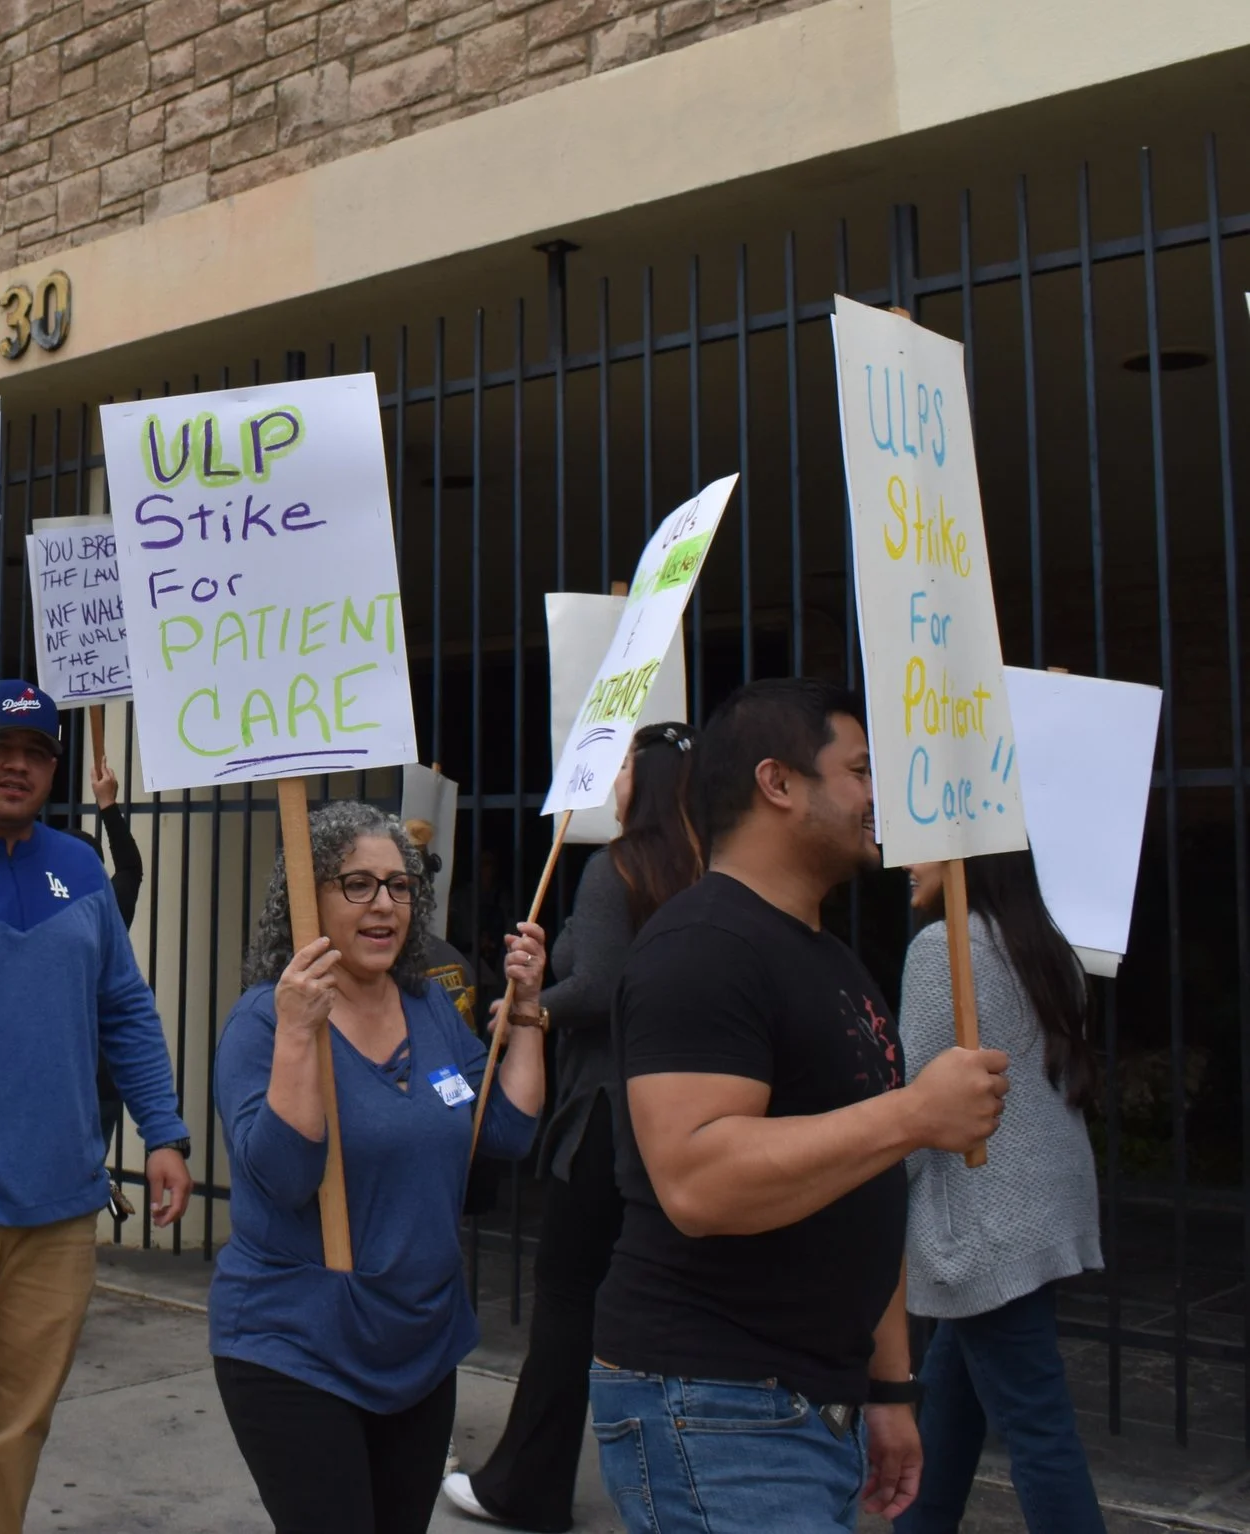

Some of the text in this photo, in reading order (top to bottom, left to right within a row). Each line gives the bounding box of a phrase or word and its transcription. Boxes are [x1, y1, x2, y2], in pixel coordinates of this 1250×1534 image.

[142, 405, 305, 488] ULP
[135, 492, 328, 550] Stike
[883, 474, 972, 579] Strike
[38, 534, 117, 567] YOU BRE
[40, 560, 120, 591] THE LAW
[149, 568, 243, 609] For
[159, 592, 401, 672] PATIENT
[910, 590, 952, 649] For
[51, 650, 100, 671] THE
[1, 697, 42, 713] Dodgers
[177, 662, 382, 757] CARE
[902, 655, 991, 741] Patient
[45, 871, 70, 899] LA
